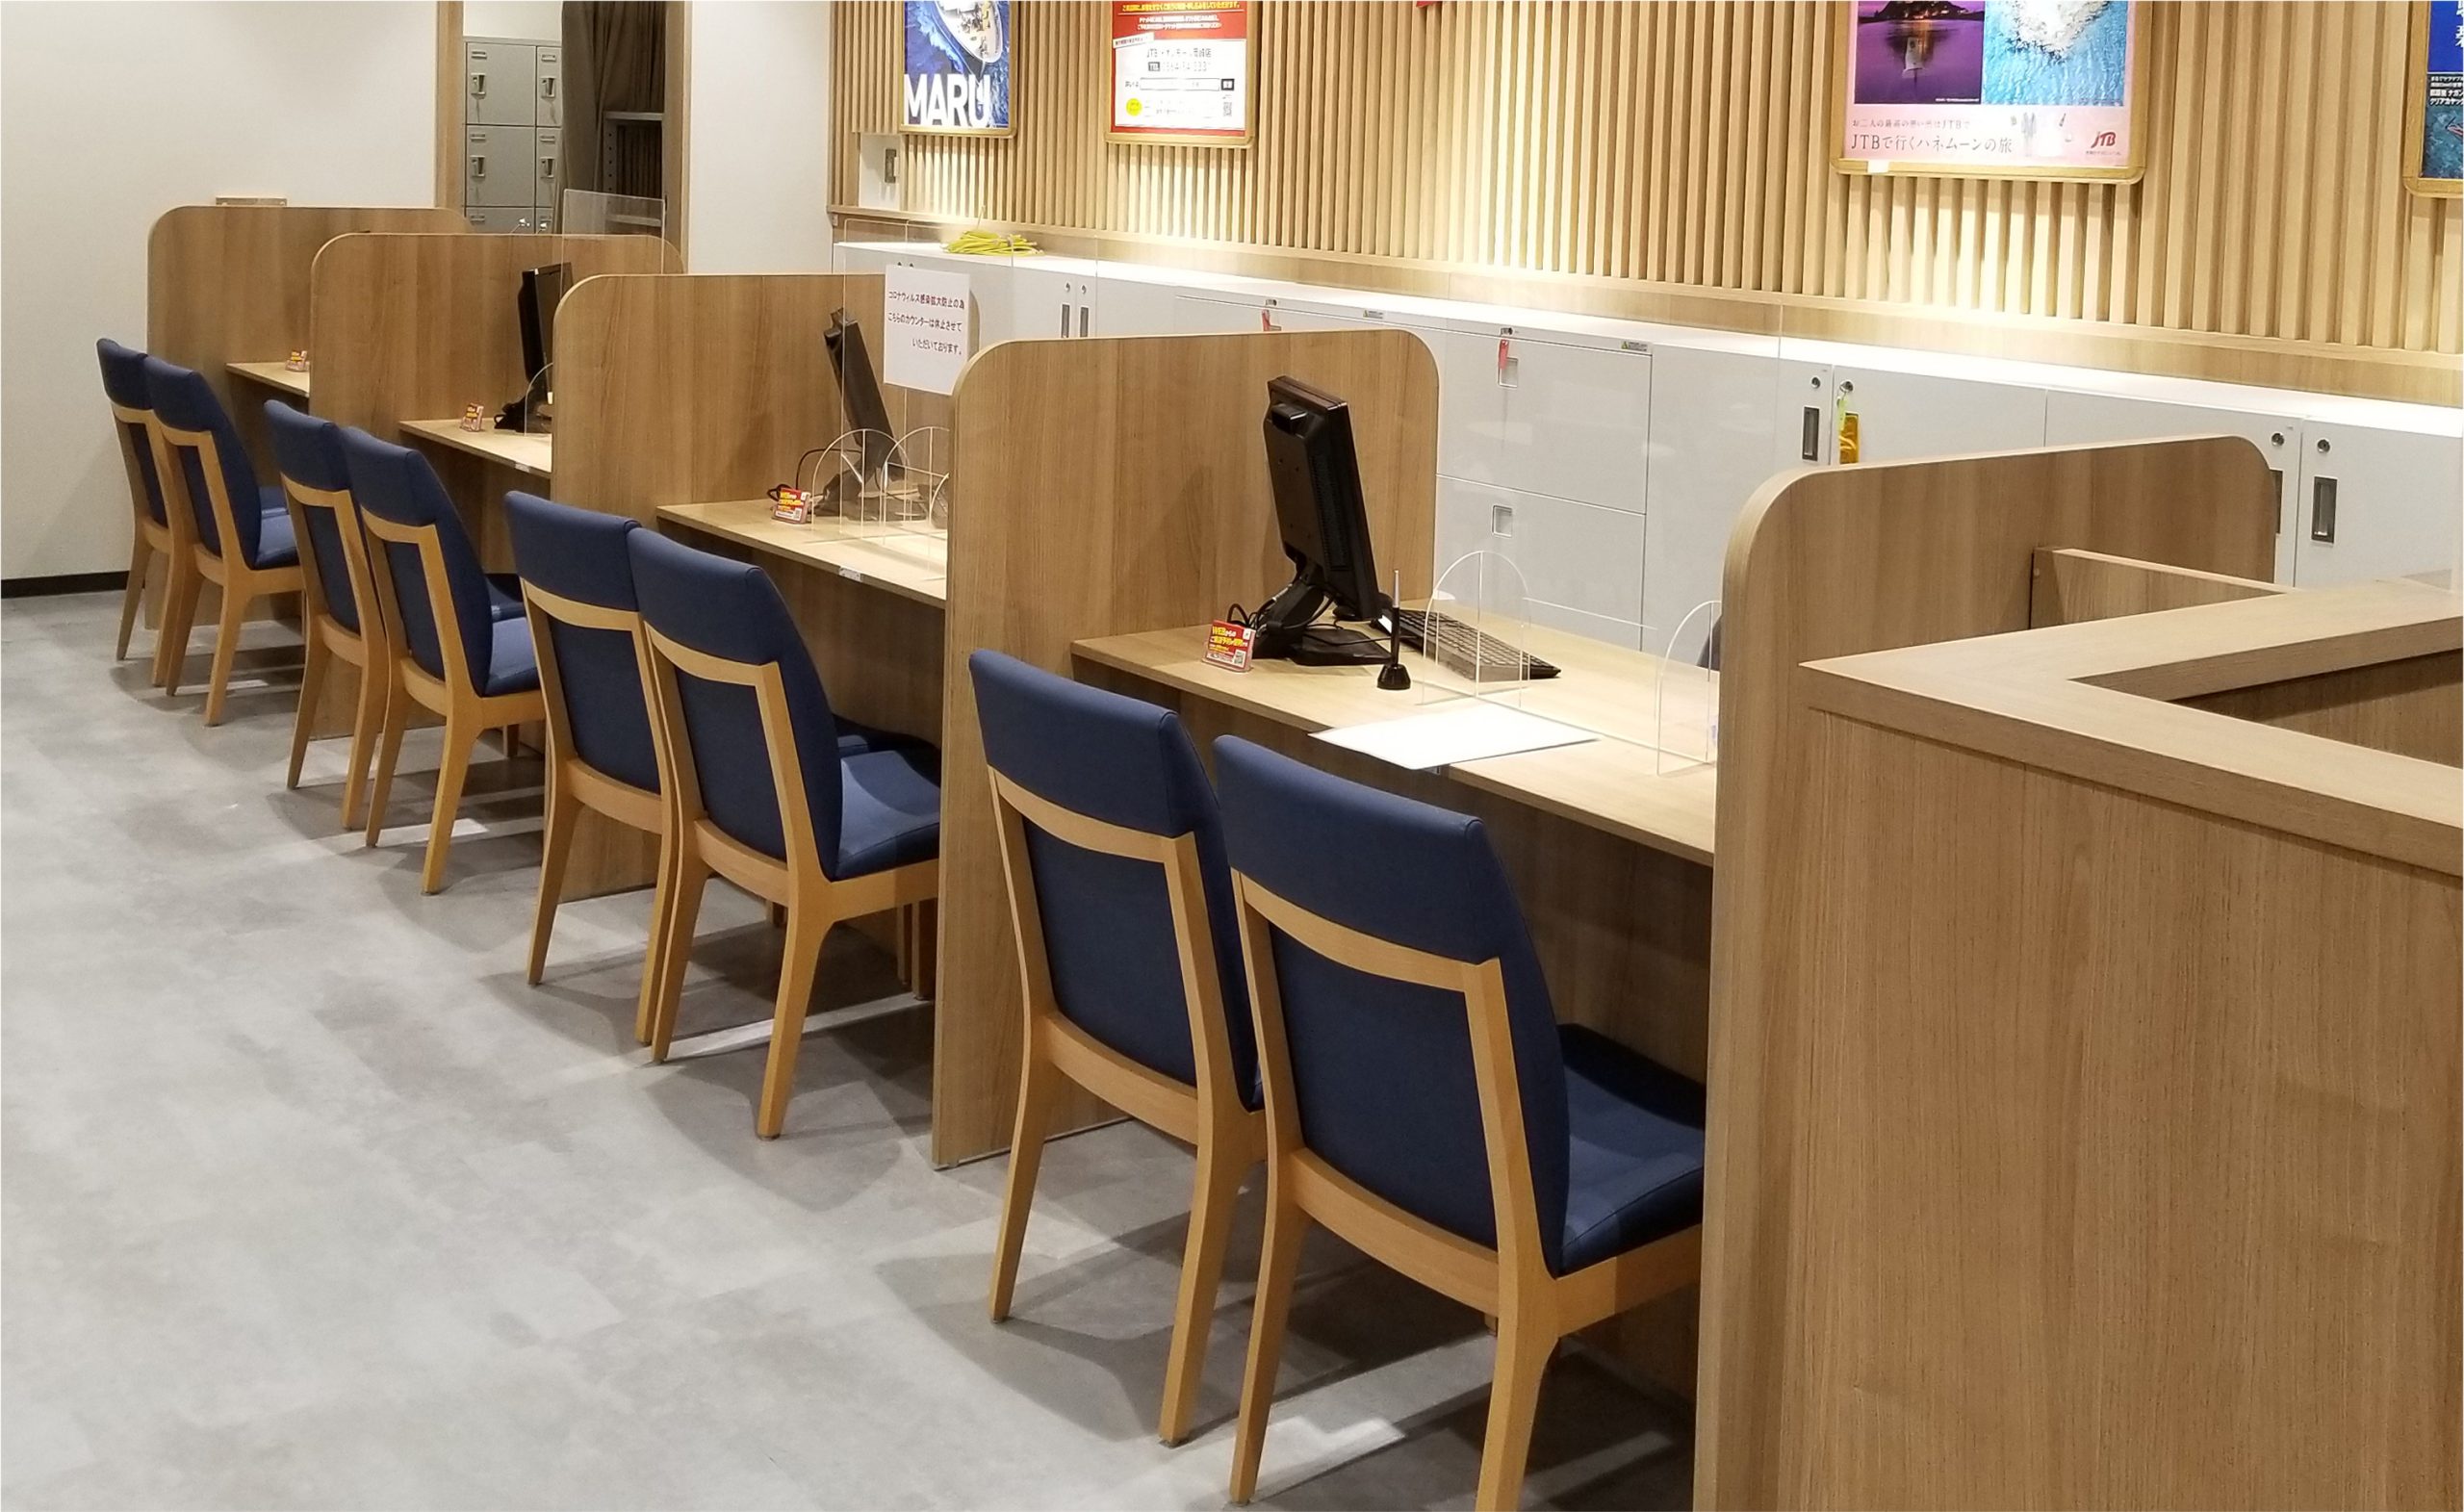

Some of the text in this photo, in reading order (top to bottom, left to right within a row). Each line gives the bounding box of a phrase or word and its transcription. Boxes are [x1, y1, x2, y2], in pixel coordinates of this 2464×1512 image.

[904, 73, 991, 127] MARU
[1851, 134, 2013, 153] JTBで行くハネムーンの旅
[2091, 131, 2117, 149] JTB
